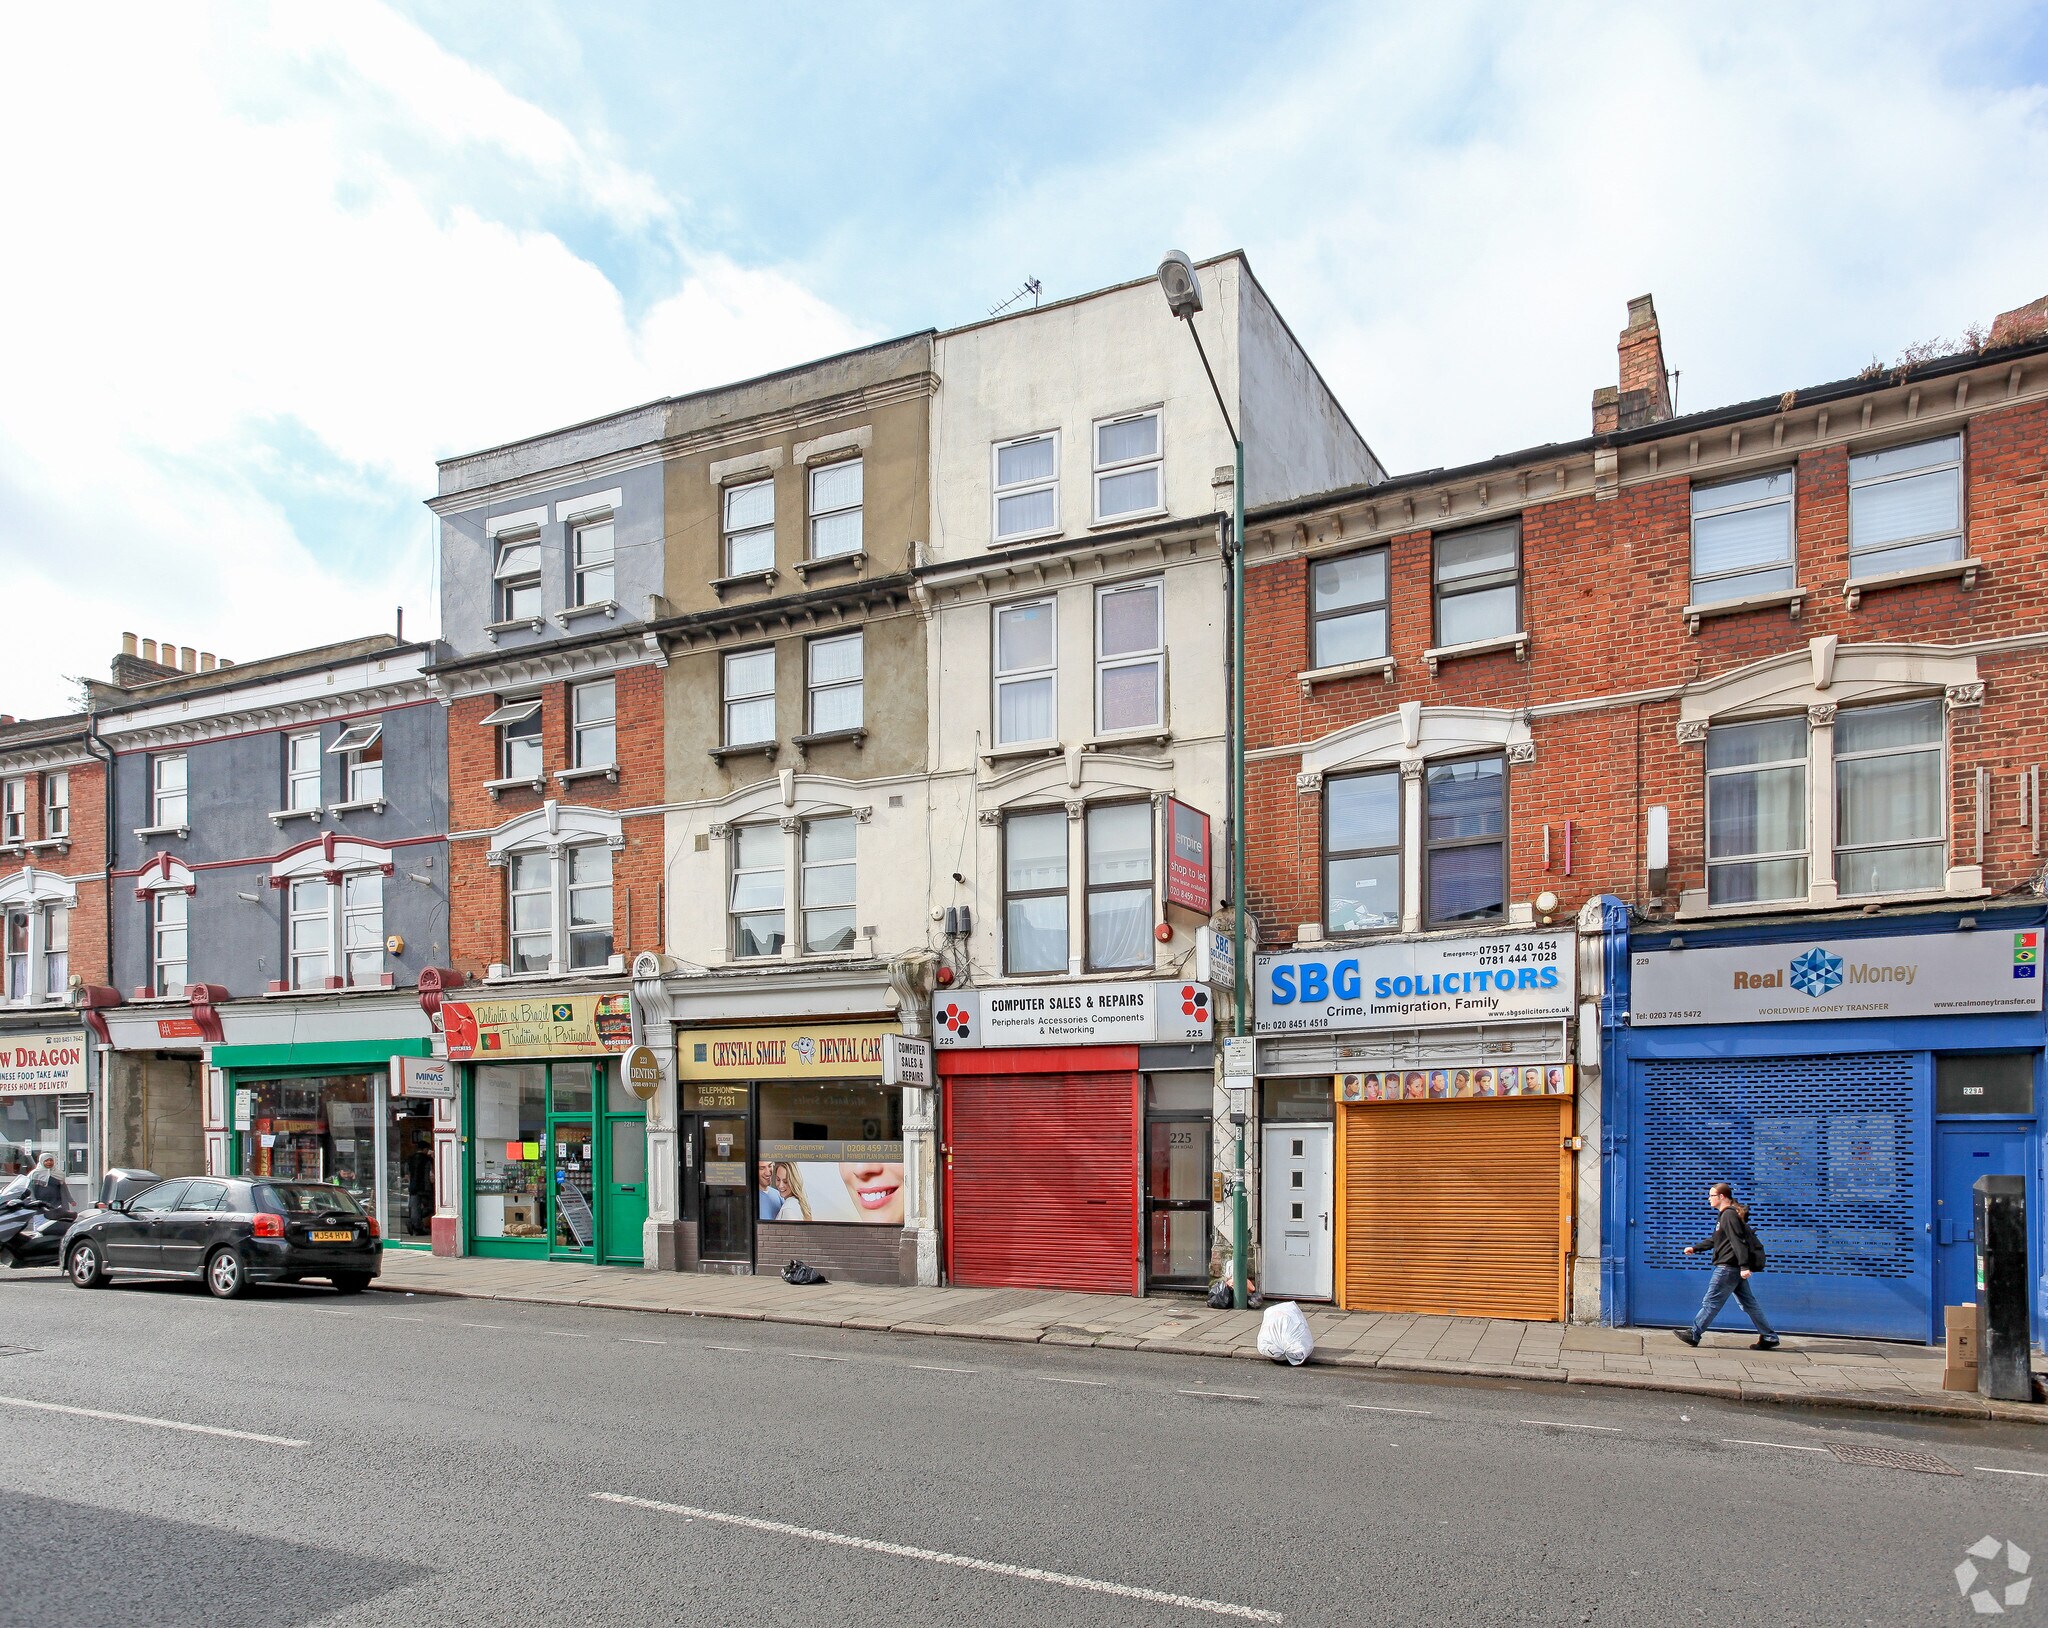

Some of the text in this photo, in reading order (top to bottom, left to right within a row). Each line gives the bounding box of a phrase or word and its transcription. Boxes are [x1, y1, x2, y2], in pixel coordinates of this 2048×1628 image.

[1176, 833, 1202, 853] empire
[1170, 861, 1207, 883] shop to let
[1170, 886, 1180, 896] 020
[1180, 890, 1194, 901] 8459
[1194, 894, 1208, 906] 7777
[1216, 934, 1229, 954] SBG
[1479, 940, 1557, 955] 07957 430 454
[1210, 947, 1234, 966] SOLICITORS
[1443, 950, 1478, 958] Emergency:
[1479, 952, 1557, 965] 0781 444 7028
[1258, 957, 1271, 965] 227
[1271, 958, 1559, 1005] SBG SOLICITORS
[1734, 963, 1918, 990] Real Money
[991, 993, 1145, 1012] COMPUTER SALES & REPAIRS
[1326, 997, 1499, 1017] Crime, Immigration, Family
[1934, 997, 2036, 1008] www.realmoneytransfer.eu
[1488, 1006, 1570, 1017] www.sbgsolicitors.co.uk
[1635, 1010, 1702, 1020] Tel: 0203 745 5472
[1758, 1003, 1889, 1015] WORLDWIDE MONEY TRANSFER
[475, 1003, 550, 1031] Delights of Brazil
[991, 1013, 1145, 1028] Peripherals Accessories Components
[1257, 1018, 1328, 1030] Tel: 020 8451 4518
[1039, 1025, 1095, 1036] & Networking
[1185, 1029, 1203, 1038] 225
[502, 1024, 593, 1051] Tradition of Portugal
[604, 1038, 632, 1046] GROCERIES
[939, 1037, 955, 1045] 225
[712, 1037, 883, 1067] CRYSTAL SMILE DENTAL CAR
[898, 1042, 926, 1056] COMPUTER
[15, 1047, 80, 1068] DRAGON
[901, 1056, 924, 1069] SALES &
[17, 1072, 35, 1080] FOOD
[36, 1070, 51, 1079] TAKE
[53, 1070, 69, 1078] AWAY
[416, 1072, 443, 1081] MINAS
[630, 1067, 657, 1080] DENTIST
[902, 1070, 924, 1082] REPAIRS
[20, 1082, 37, 1091] HOME
[39, 1081, 68, 1090] DELIVERY
[698, 1086, 735, 1094] TELEPHONE
[699, 1096, 735, 1106] 459 7131
[1170, 1132, 1192, 1143] 225
[847, 1144, 903, 1152] 0208 459 7131
[314, 1231, 350, 1239] MJ54 HYA
